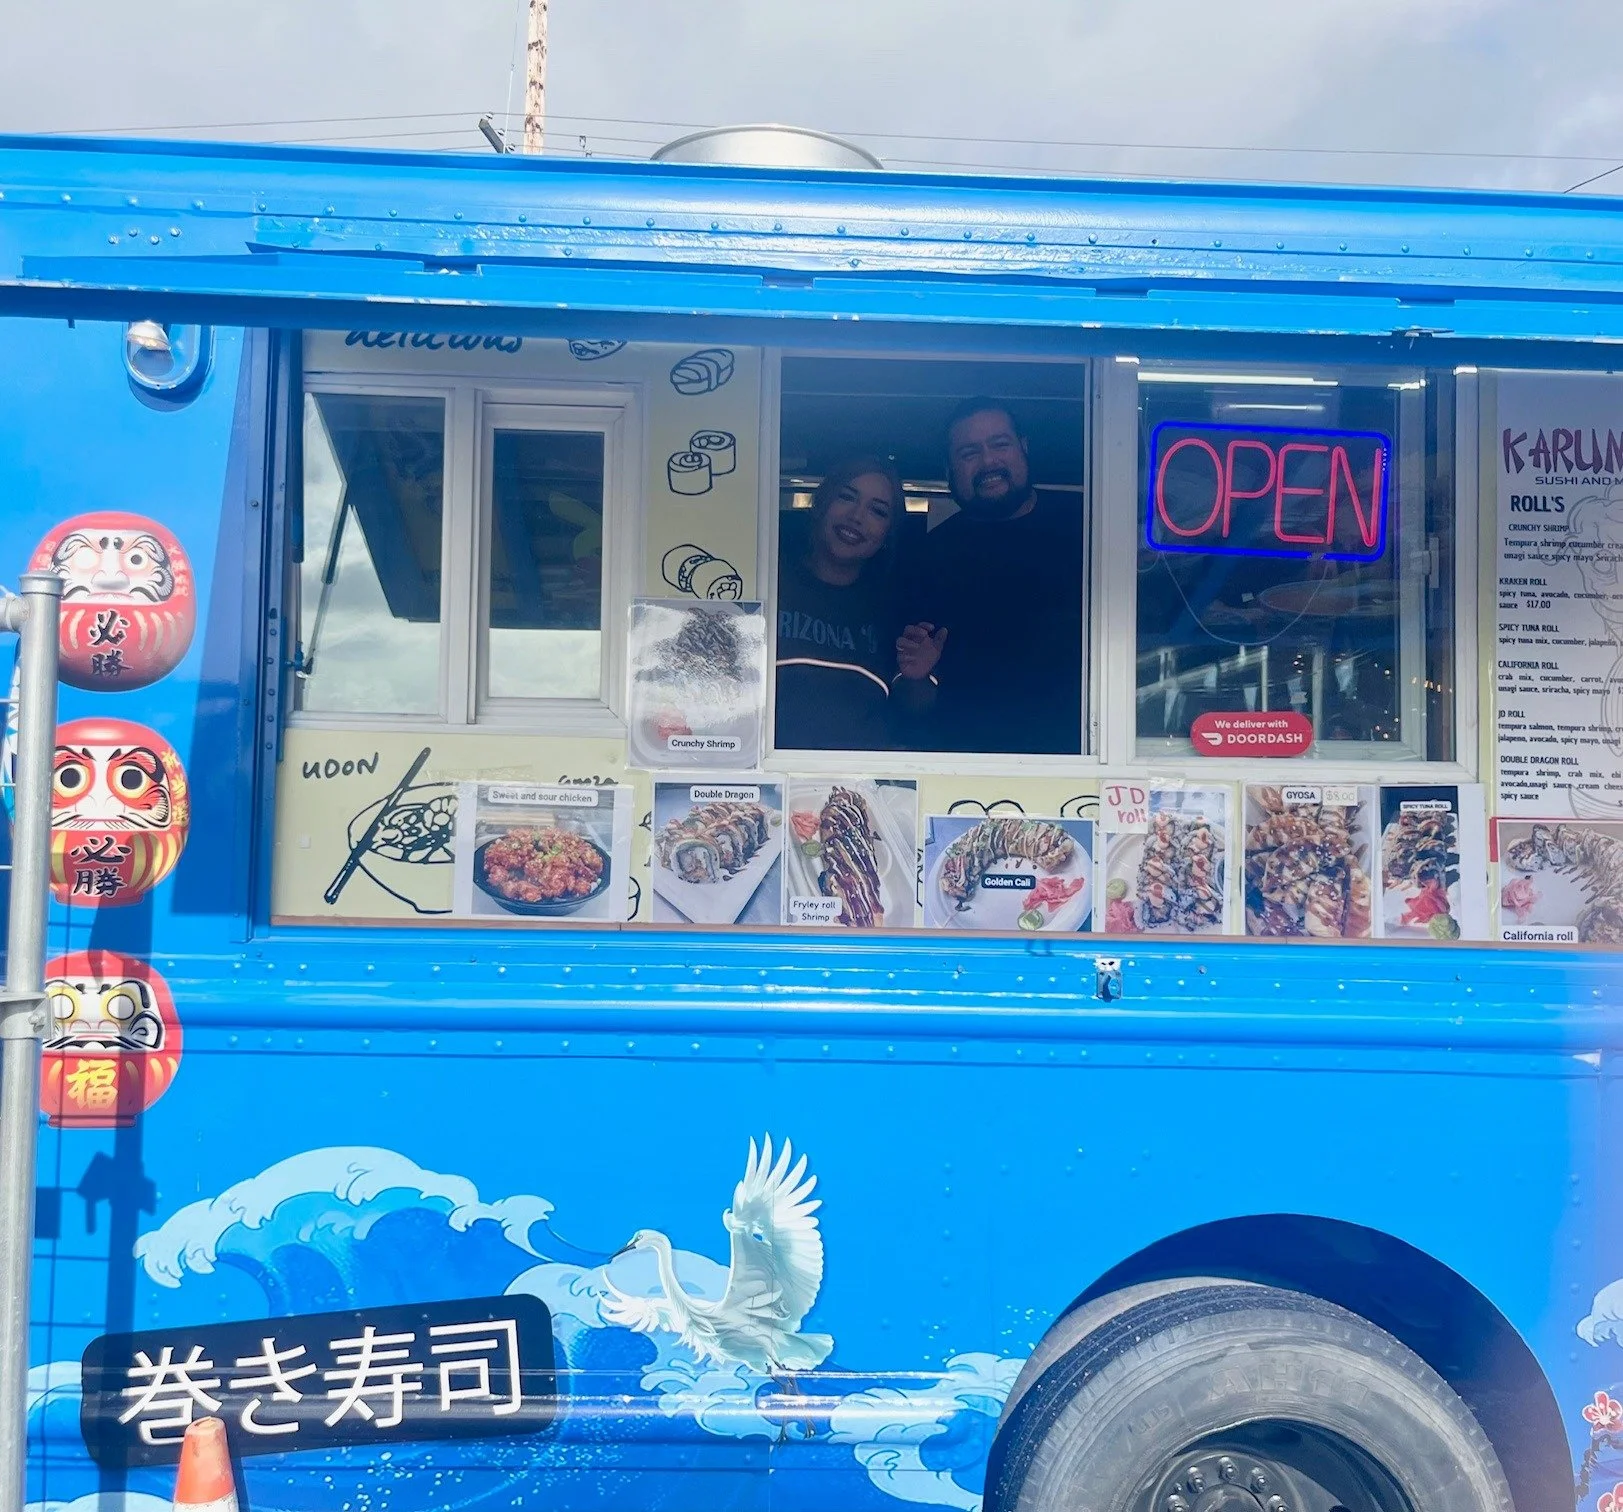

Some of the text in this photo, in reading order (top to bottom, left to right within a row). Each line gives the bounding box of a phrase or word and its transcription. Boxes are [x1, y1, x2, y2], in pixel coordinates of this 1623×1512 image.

[1535, 476, 1578, 485] SUSHI
[1581, 476, 1611, 486] AND
[1156, 438, 1383, 548] OPEN
[1510, 495, 1565, 513] ROLL'S
[1508, 524, 1569, 532] CRUNCHY SHRIMP
[1504, 537, 1537, 548] Tempura
[1540, 538, 1566, 549] shrimp
[1568, 541, 1605, 549] cucumber
[1504, 552, 1525, 561] unagi
[1551, 553, 1571, 562] spicy
[1573, 555, 1593, 563] mayo
[1500, 589, 1516, 599] spicy
[1541, 591, 1570, 599] avocado,
[1499, 623, 1519, 631] SPICY
[1522, 624, 1539, 632] TUNA
[88, 609, 133, 677] 必勝
[1499, 636, 1515, 645] spicy
[1498, 660, 1559, 670] CALIFORNIA ROLL
[1498, 685, 1517, 693] unagi
[1573, 687, 1590, 696] spicy
[1498, 710, 1505, 719] JD
[1215, 719, 1289, 729] We deliver with
[1498, 723, 1527, 731] tempura
[1557, 725, 1585, 733] tempura
[1227, 733, 1303, 744] DOORDASH
[1530, 735, 1559, 743] avocado,
[1561, 736, 1577, 745] spicy
[671, 739, 736, 749] Crunchy Shrimp
[1500, 755, 1579, 765] DOUBLE DRAGON ROLL
[1500, 769, 1529, 777] tempura
[493, 791, 518, 800] Sweet
[521, 793, 537, 801] and
[559, 794, 592, 803] chicken
[694, 790, 754, 800] Double Dragon
[1286, 791, 1316, 799] GYOSA
[1500, 792, 1518, 801] spicy
[1118, 808, 1147, 823] roll
[71, 837, 132, 897] 必勝
[985, 878, 1014, 886] Golden
[801, 913, 830, 922] Shrimp
[1503, 931, 1573, 941] California roll
[66, 1058, 118, 1110] 福
[118, 1319, 523, 1446] 巻き寿司
